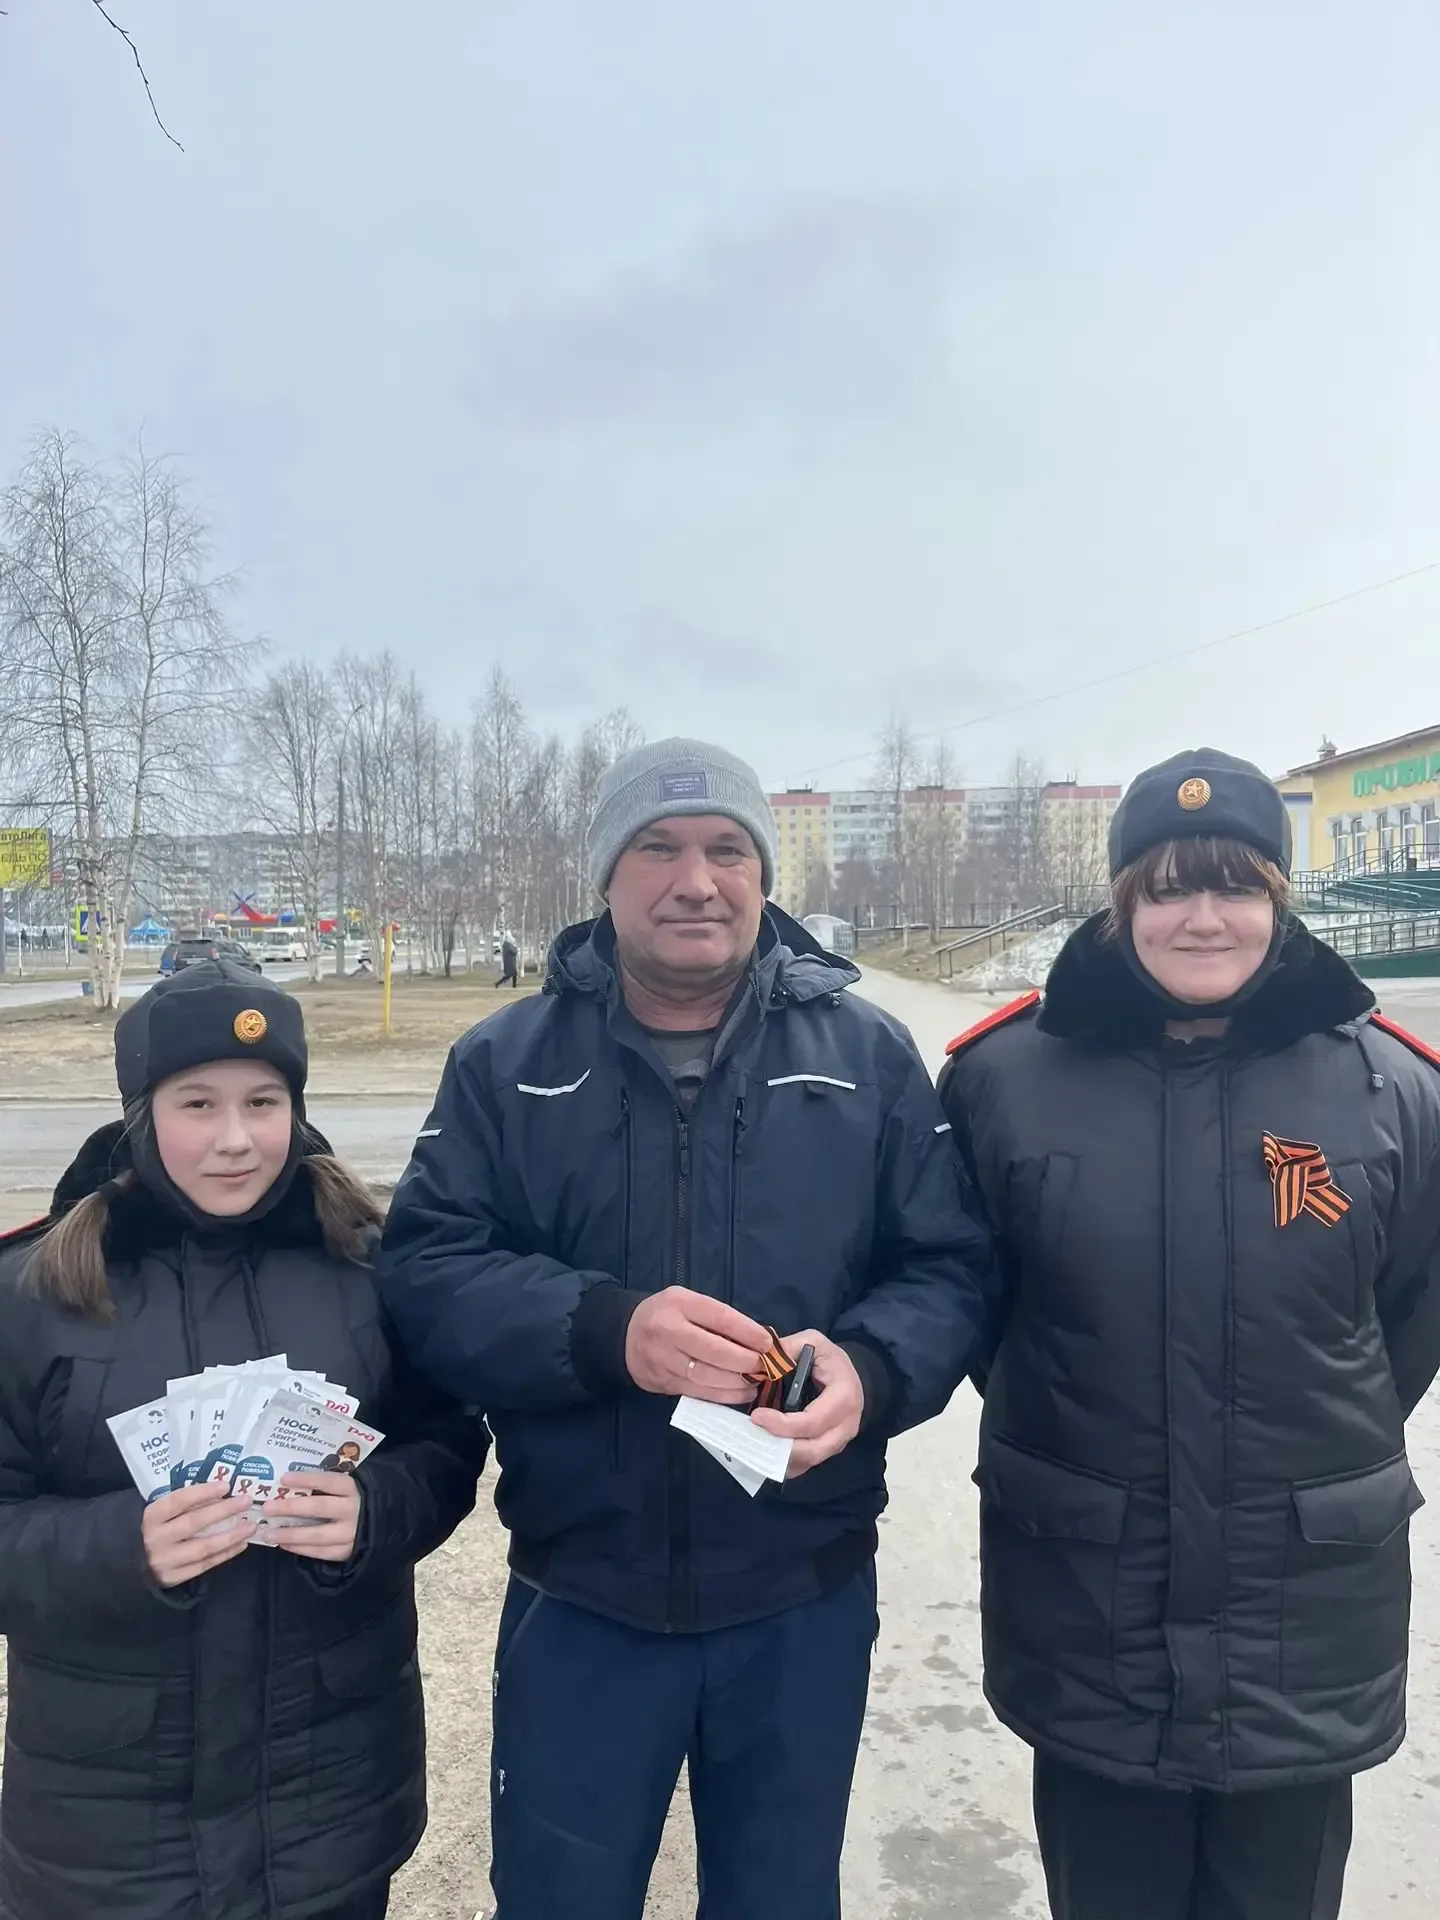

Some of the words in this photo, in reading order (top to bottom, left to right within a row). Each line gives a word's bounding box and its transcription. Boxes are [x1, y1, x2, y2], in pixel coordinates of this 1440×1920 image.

[0, 831, 46, 841] втоЛига
[278, 1416, 319, 1435] НОСИ
[141, 1432, 169, 1452] НОС
[269, 1433, 297, 1443] ЛЕНТУ
[273, 1426, 337, 1449] ГЕОРГИЕВСКУЮ
[274, 1442, 325, 1457] УВАЖЕНИЕМ
